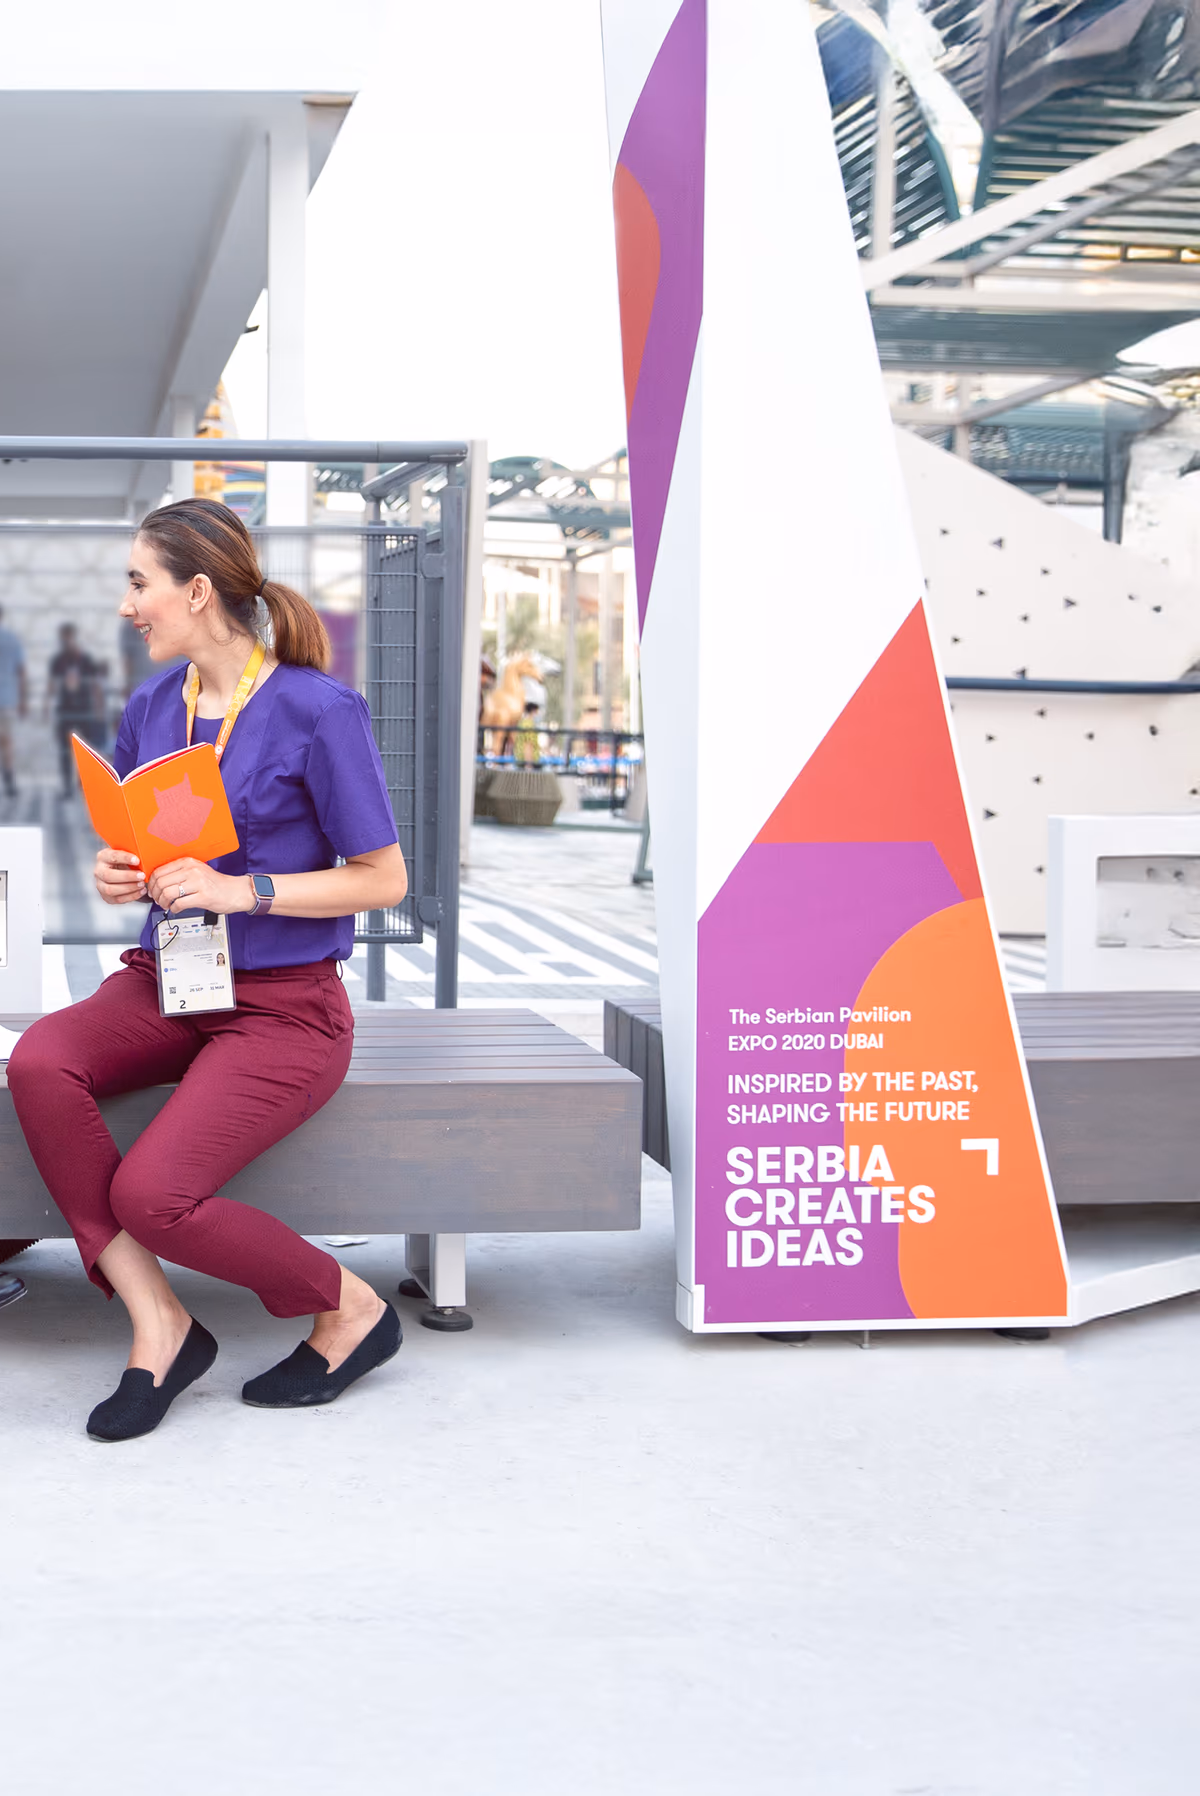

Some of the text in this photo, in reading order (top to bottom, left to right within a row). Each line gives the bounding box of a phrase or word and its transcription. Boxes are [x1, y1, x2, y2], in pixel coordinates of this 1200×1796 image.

[179, 1000, 186, 1009] 2
[729, 1006, 912, 1025] The Serbian Pavilion
[728, 1033, 884, 1051] EXPO 2020 DUBAI
[728, 1070, 979, 1094] INSPIRED BY THE PAST,
[726, 1100, 970, 1125] SHAPING THE FUTURE
[725, 1144, 895, 1185] SERBIA
[725, 1184, 936, 1227] CREATES
[726, 1226, 864, 1268] IDEAS
